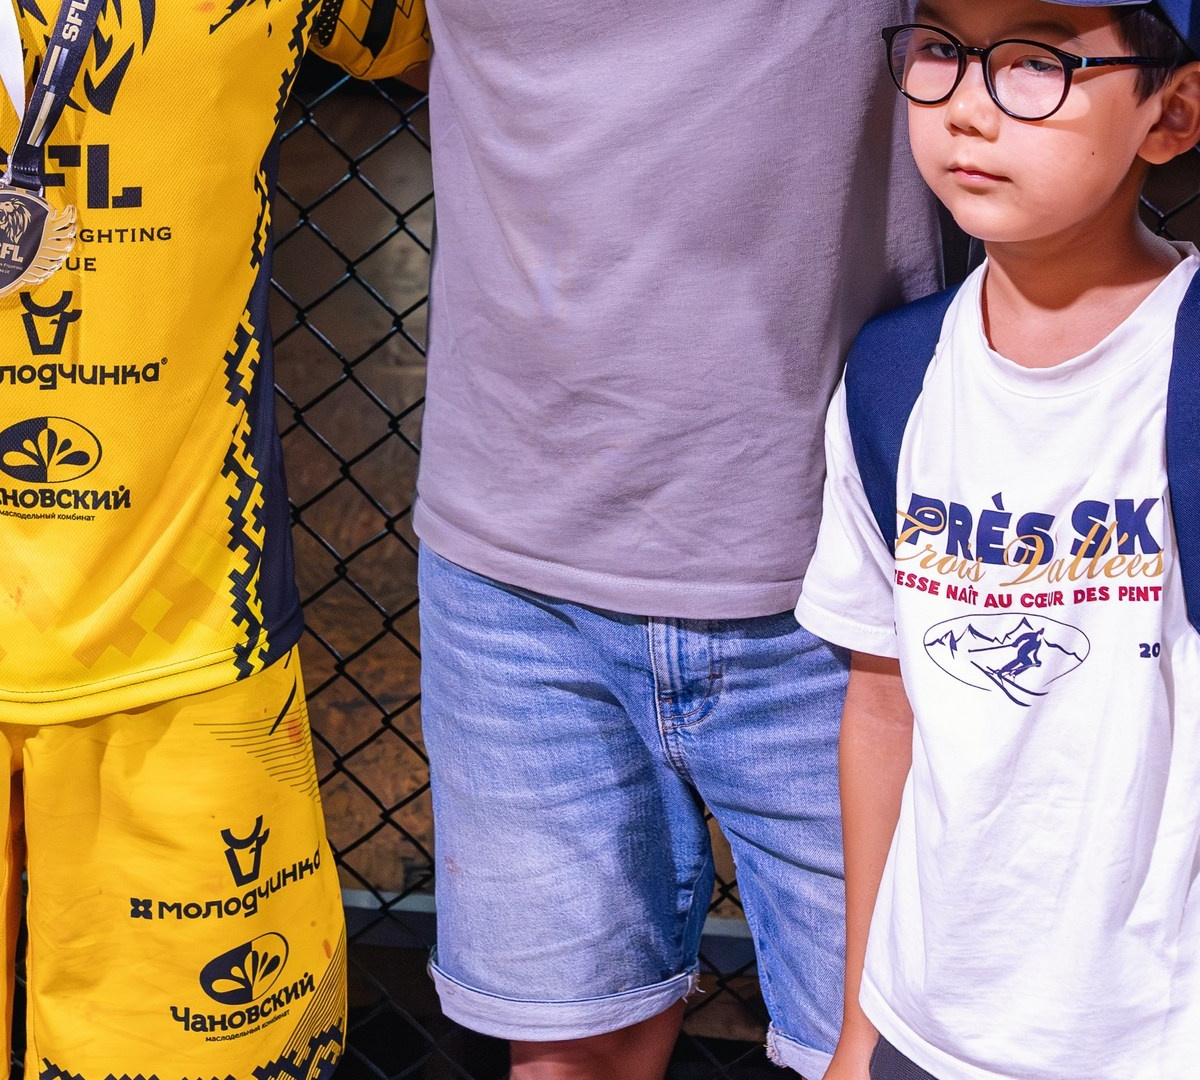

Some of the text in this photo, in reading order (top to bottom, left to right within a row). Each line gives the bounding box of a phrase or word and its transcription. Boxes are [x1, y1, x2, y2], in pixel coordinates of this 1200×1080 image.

[76, 226, 172, 244] GHTING
[57, 512, 96, 521] комбинат
[999, 521, 1164, 587] Vallées
[894, 569, 941, 596] ESSE
[946, 585, 978, 605] NAÎT
[984, 593, 1012, 608] AU
[1074, 586, 1109, 604] DES
[170, 972, 315, 1032] Чановский
